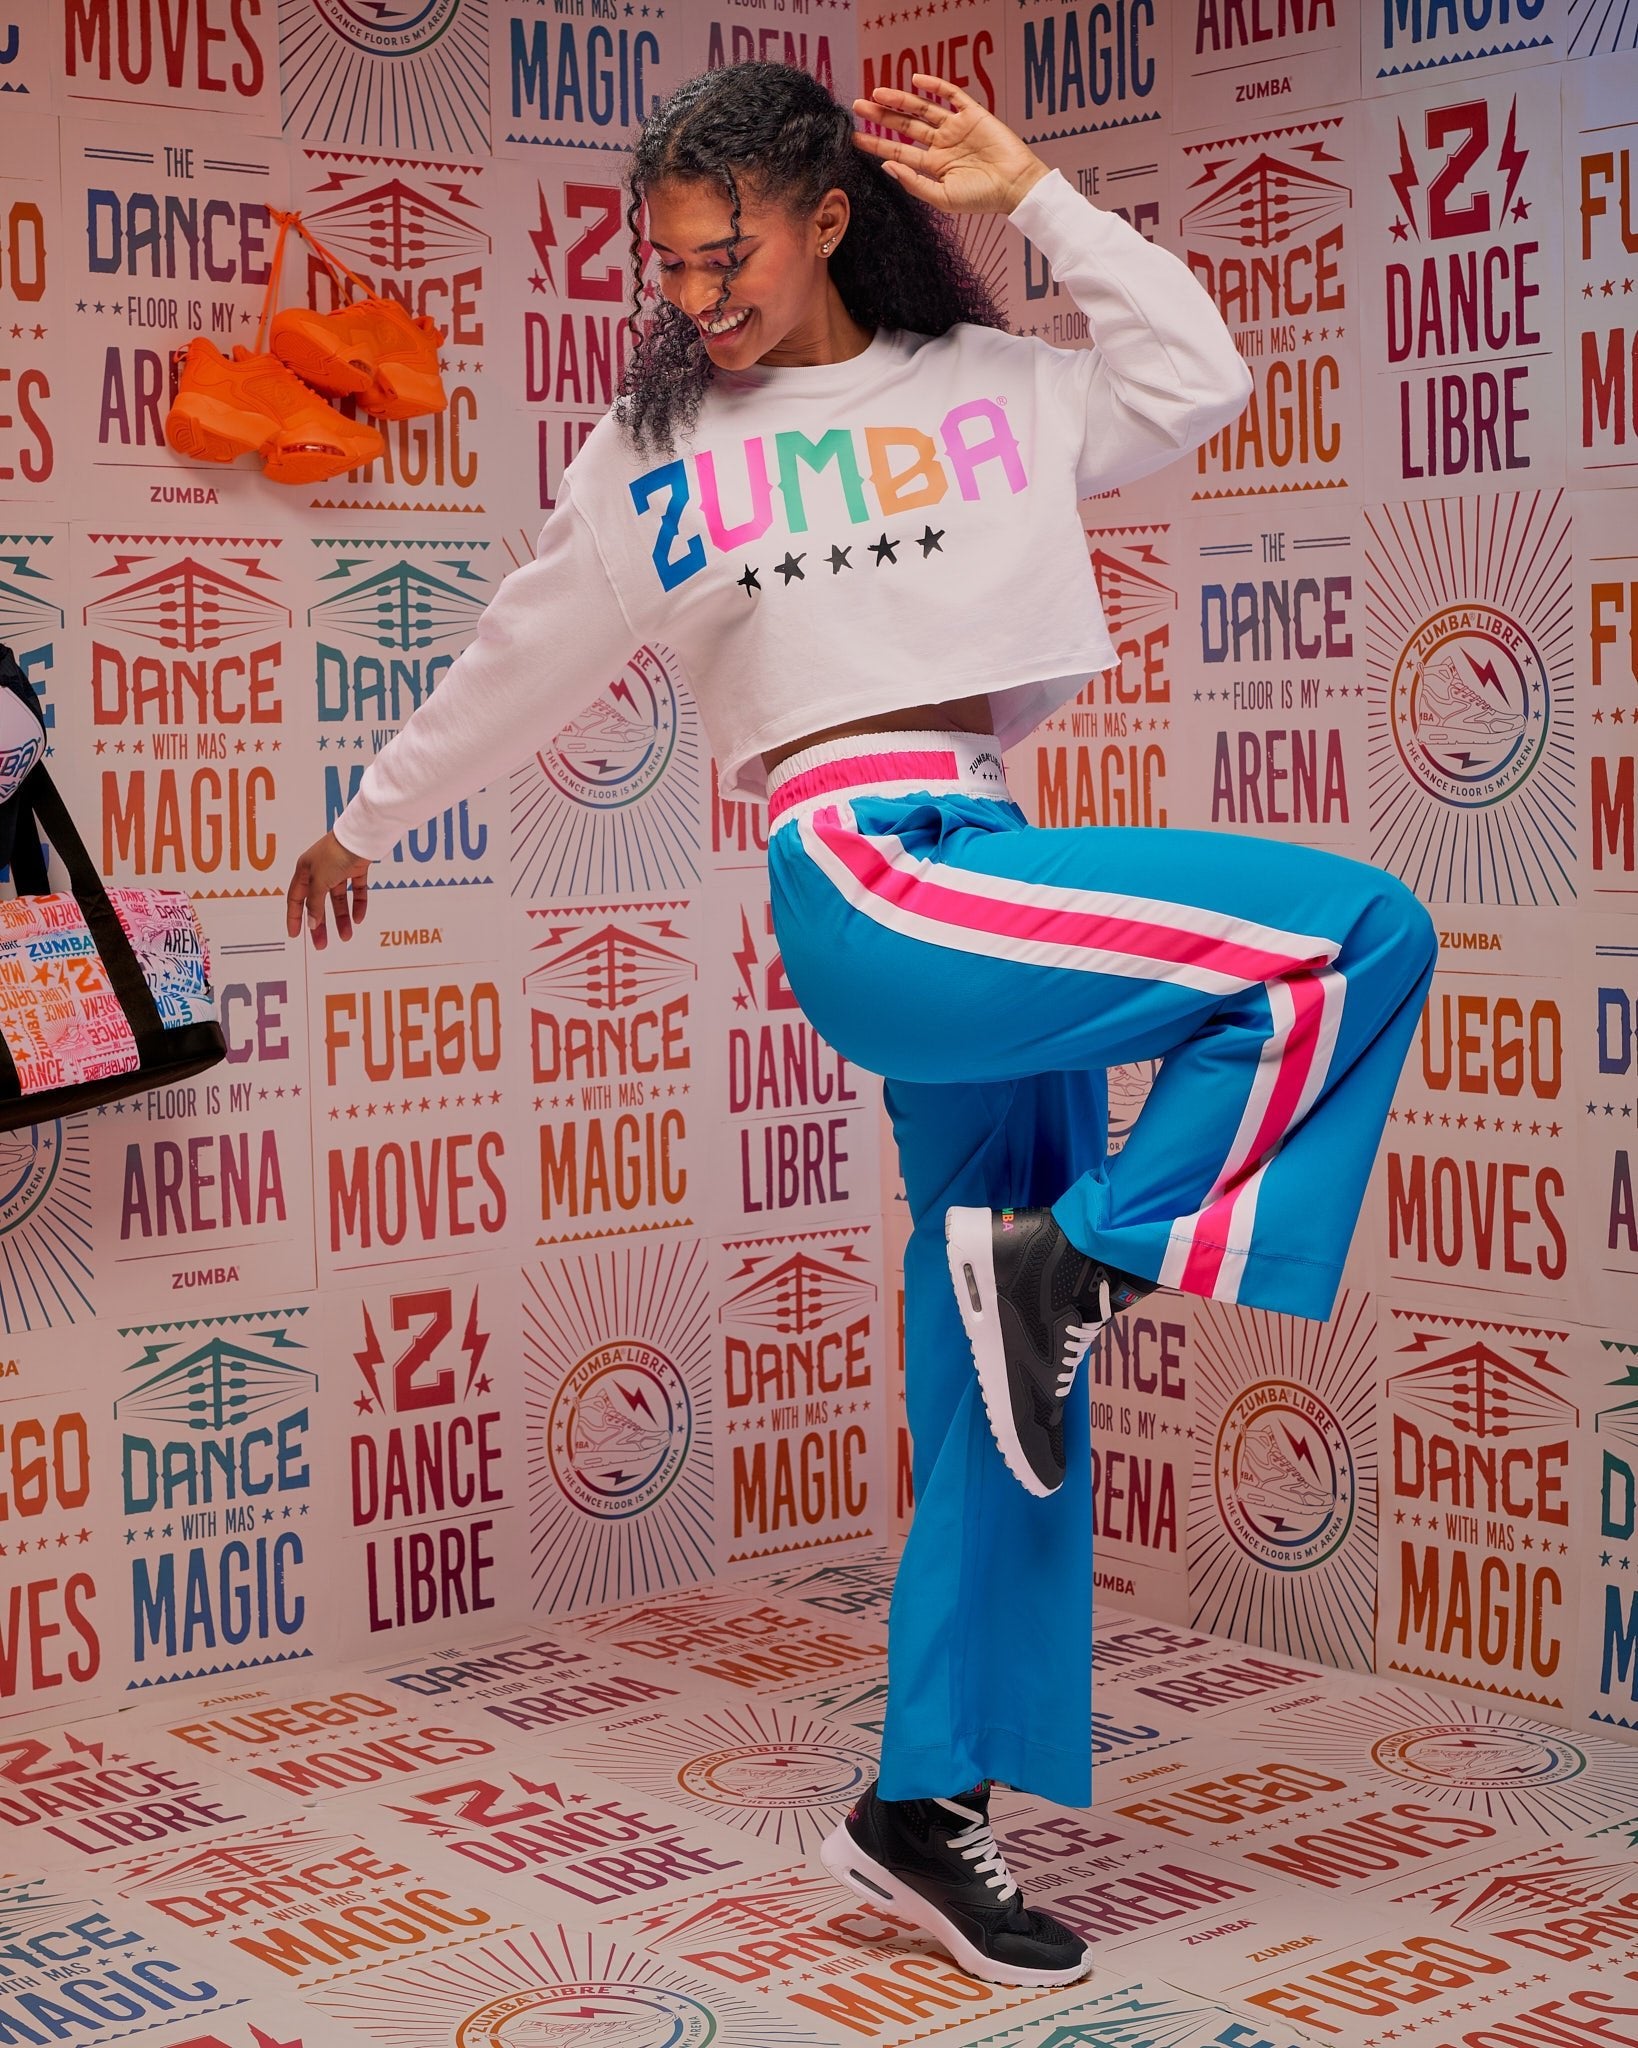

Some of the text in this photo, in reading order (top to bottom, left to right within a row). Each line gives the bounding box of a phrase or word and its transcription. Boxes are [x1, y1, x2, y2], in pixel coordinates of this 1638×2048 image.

[65, 0, 264, 97] MOVES
[330, 8, 427, 46] DANCE FLOOR IS MY
[509, 17, 660, 127] MAGIC
[1024, 0, 1155, 120] MAGIC
[164, 147, 194, 179] THE
[86, 188, 272, 285] DANCE
[1187, 223, 1345, 325] DANCE
[1386, 242, 1541, 364] DANCE
[128, 297, 235, 333] FLOOR IS MY
[1234, 325, 1296, 356] WITH MAS
[1400, 366, 1530, 481] LIBRE
[1260, 532, 1286, 563] THE
[1200, 576, 1353, 663] DANCE
[1477, 613, 1523, 652] LIBRE
[91, 641, 283, 726] DANCE
[1234, 679, 1321, 710] FLOOR IS MY
[152, 733, 227, 760] WITH MAS
[1072, 713, 1127, 738] WITH MAS
[557, 745, 665, 799] DANCE FLOOR IS MY ARENA
[1037, 745, 1167, 828] MAGIC
[1211, 729, 1350, 824] ARENA
[1406, 737, 1535, 797] THE DANCE FLOOR IS MY ARENA
[101, 767, 277, 876] MAGIC
[324, 982, 501, 1086] FUEGO
[530, 994, 690, 1084] DANCE
[18, 1059, 65, 1089] DANCE
[147, 1082, 253, 1122] FLOOR IS MY
[581, 1081, 644, 1111] WITH MAS
[2, 1164, 46, 1221] MY ARENA
[120, 1129, 287, 1241] ARENA
[328, 1130, 508, 1252] MOVES
[538, 1108, 688, 1221] MAGIC
[740, 1118, 849, 1214] LIBRE
[1387, 1152, 1567, 1280] MOVES
[627, 1348, 668, 1378] LIBRE
[725, 1314, 871, 1409] DANCE
[771, 1400, 828, 1431] WITH MAS
[1120, 1408, 1133, 1437] IS
[1138, 1410, 1157, 1440] MY
[1293, 1392, 1333, 1435] LIBRE
[121, 1406, 310, 1516] DANCE
[351, 1411, 503, 1527] DANCE
[562, 1449, 679, 1510] THE DANCE FLOOR IS MY ARENA
[732, 1425, 867, 1539] MAGIC
[1393, 1413, 1569, 1527] DANCE
[181, 1505, 255, 1541] WITH MAS
[1225, 1496, 1343, 1561] THE DANCE FLOOR IS MY ARENA
[1446, 1513, 1514, 1552] WITH MAS
[132, 1531, 305, 1662] MAGIC
[366, 1519, 495, 1633] LIBRE
[611, 1605, 810, 1661] DANCE
[1397, 1540, 1562, 1679] MAGIC
[386, 1641, 585, 1696] DANCE
[434, 1648, 462, 1660] THE
[689, 1633, 887, 1689] MAGIC
[717, 1635, 782, 1657] WITH MAS
[476, 1668, 582, 1702] FLOOR IS MY
[483, 1677, 680, 1731] ARENA
[1134, 1657, 1323, 1713] ARENA
[167, 1693, 397, 1753] FUEGO
[737, 1745, 799, 1755] LIBRE
[1418, 1727, 1477, 1736] LIBRE
[247, 1727, 497, 1797] MOVES
[42, 1793, 247, 1855] LIBRE
[1113, 1762, 1349, 1838] FUEGO
[445, 1802, 677, 1874] DANCE
[1075, 1856, 1121, 1880] IS MY
[1243, 1803, 1497, 1890] MOVES
[145, 1846, 411, 1928] DANCE
[533, 1837, 743, 1906] LIBRE
[228, 1888, 492, 1977] MAGIC
[268, 1890, 368, 1922] WITH MAS
[1047, 1863, 1255, 1944] ARENA
[46, 1962, 90, 1981] MAS
[812, 1942, 910, 1978] WITH MAS
[1242, 1936, 1511, 2033] FUEGO
[535, 1986, 612, 1999] LIBRE
[690, 2015, 702, 2036] ARENA
